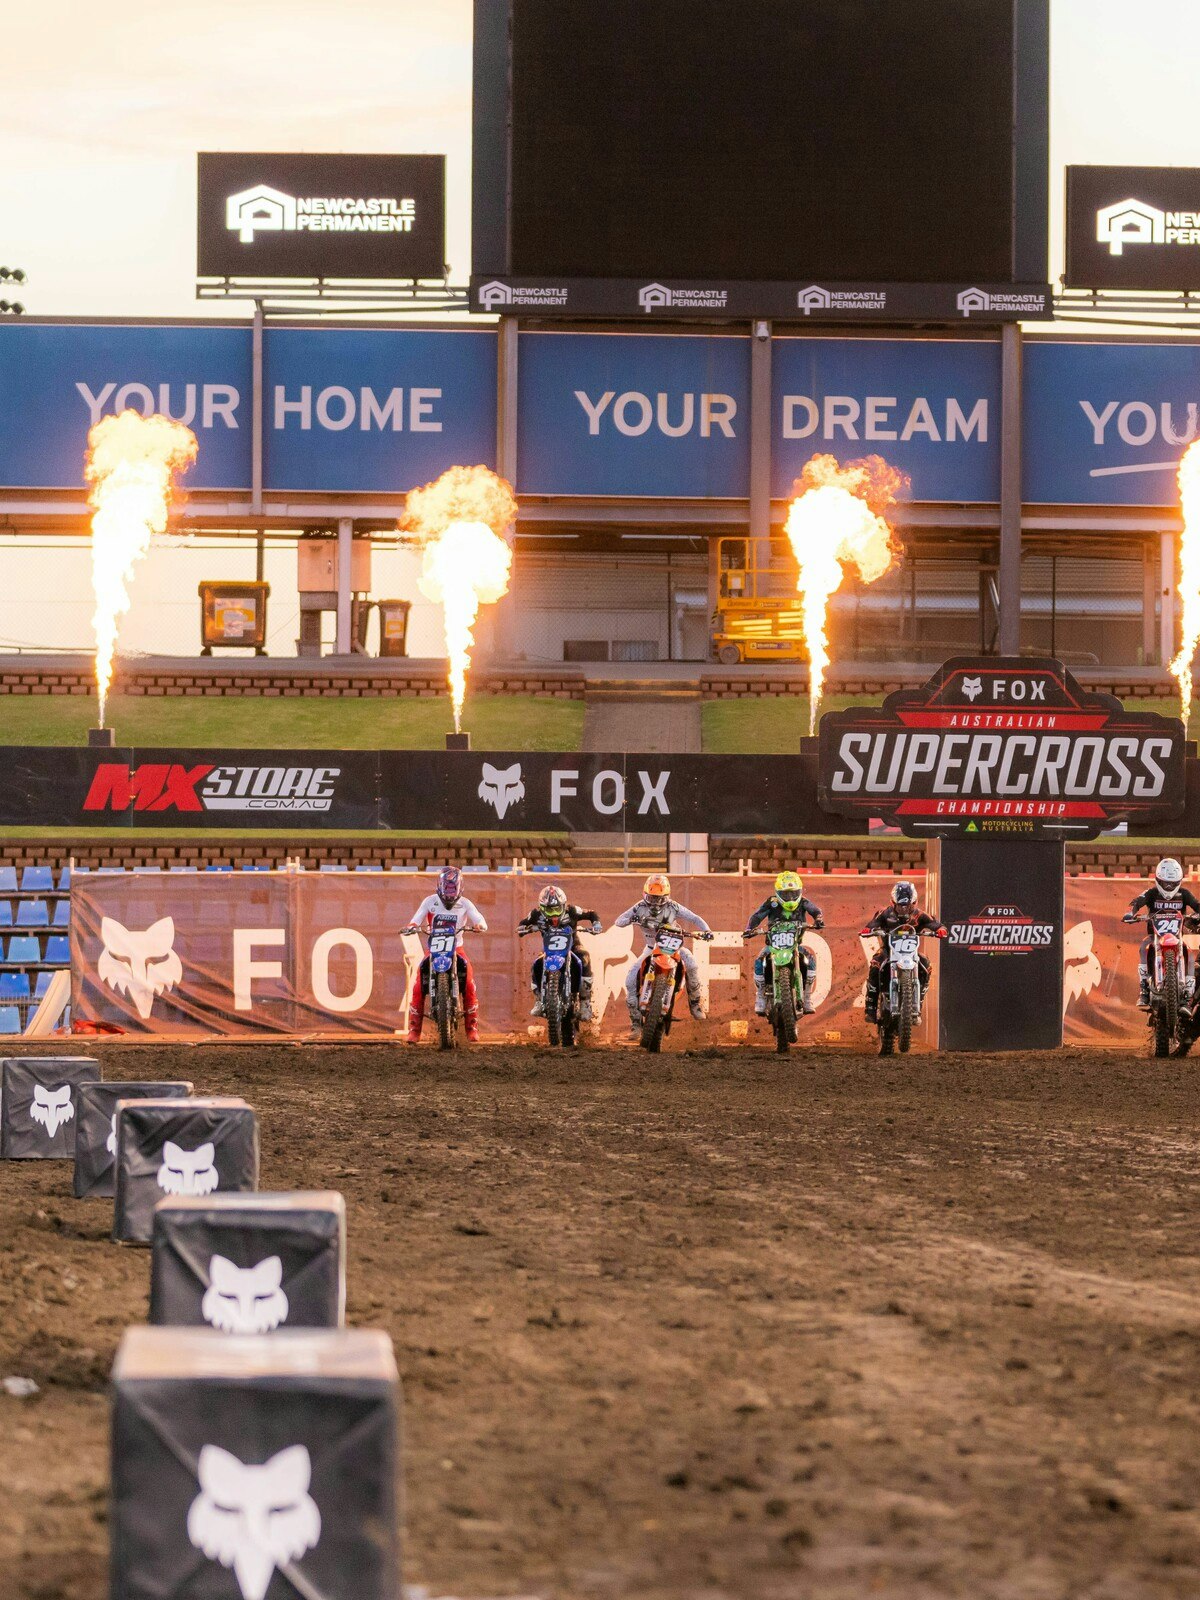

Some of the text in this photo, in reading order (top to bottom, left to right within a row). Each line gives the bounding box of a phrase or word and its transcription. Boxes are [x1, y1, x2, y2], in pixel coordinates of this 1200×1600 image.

[297, 197, 415, 215] NEWCASTLE
[297, 215, 415, 231] PERMANENT
[512, 288, 568, 297] NEWCASTLE
[672, 290, 728, 299] NEWCASTLE
[831, 292, 886, 300] NEWCASTLE
[990, 294, 1045, 303] NEWCASTLE
[512, 296, 568, 305] PERMANENT
[672, 298, 728, 307] PERMANENT
[831, 301, 886, 309] PERMANENT
[990, 303, 1045, 311] PERMANENT
[274, 385, 442, 432] HOME
[574, 390, 988, 442] YOUR DREAM
[993, 680, 1046, 700] FOX
[950, 715, 1056, 728] AUSTRALIAN
[831, 733, 1173, 797] SUPERCROSS
[550, 770, 671, 815] FOX
[245, 800, 329, 810] .COM.AU
[937, 801, 1066, 815] CHAMPIONSHIP
[1158, 919, 1179, 934] 24
[658, 935, 684, 949] 38
[772, 932, 795, 947] 386
[948, 925, 1054, 945] SUPERCROSS
[430, 936, 455, 953] 51
[548, 935, 568, 951] 3
[892, 939, 916, 953] 16
